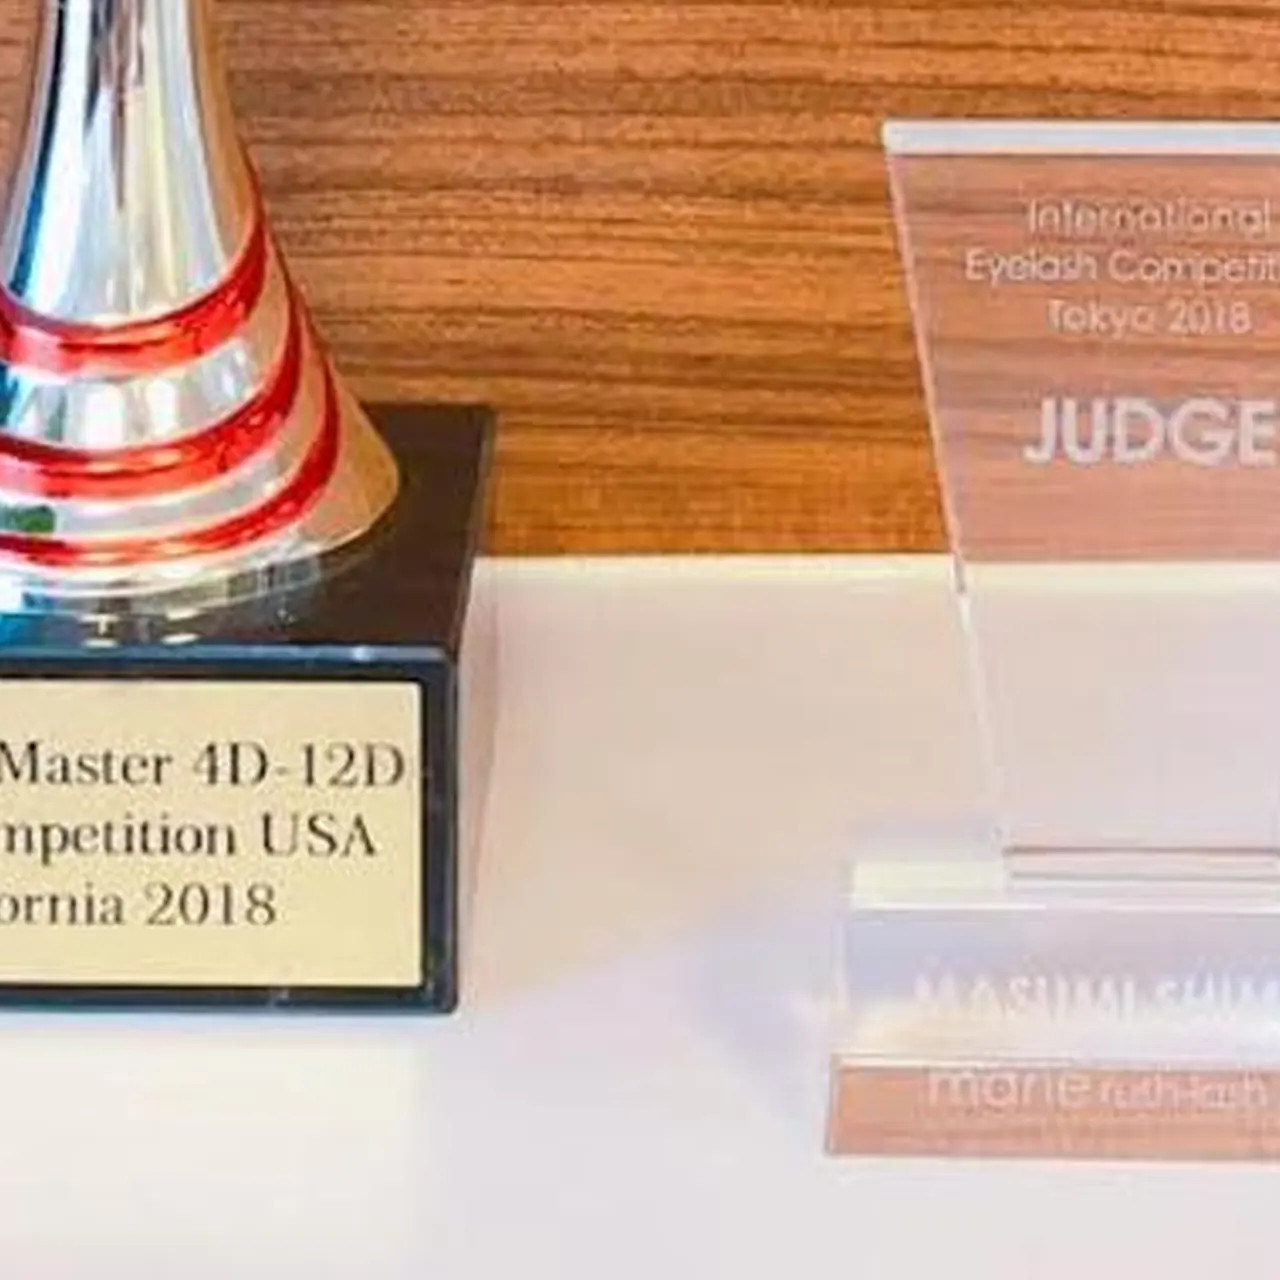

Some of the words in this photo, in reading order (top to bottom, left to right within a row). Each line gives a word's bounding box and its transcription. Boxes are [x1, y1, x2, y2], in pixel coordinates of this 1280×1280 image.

[1028, 197, 1271, 235] International
[964, 246, 1098, 288] Eyelash
[1046, 298, 1156, 339] Tokyo
[1167, 298, 1254, 335] 2018
[1023, 397, 1279, 468] JUDGE
[192, 739, 408, 789] 4D-12D
[260, 810, 379, 860] USA
[144, 880, 278, 928] 2018
